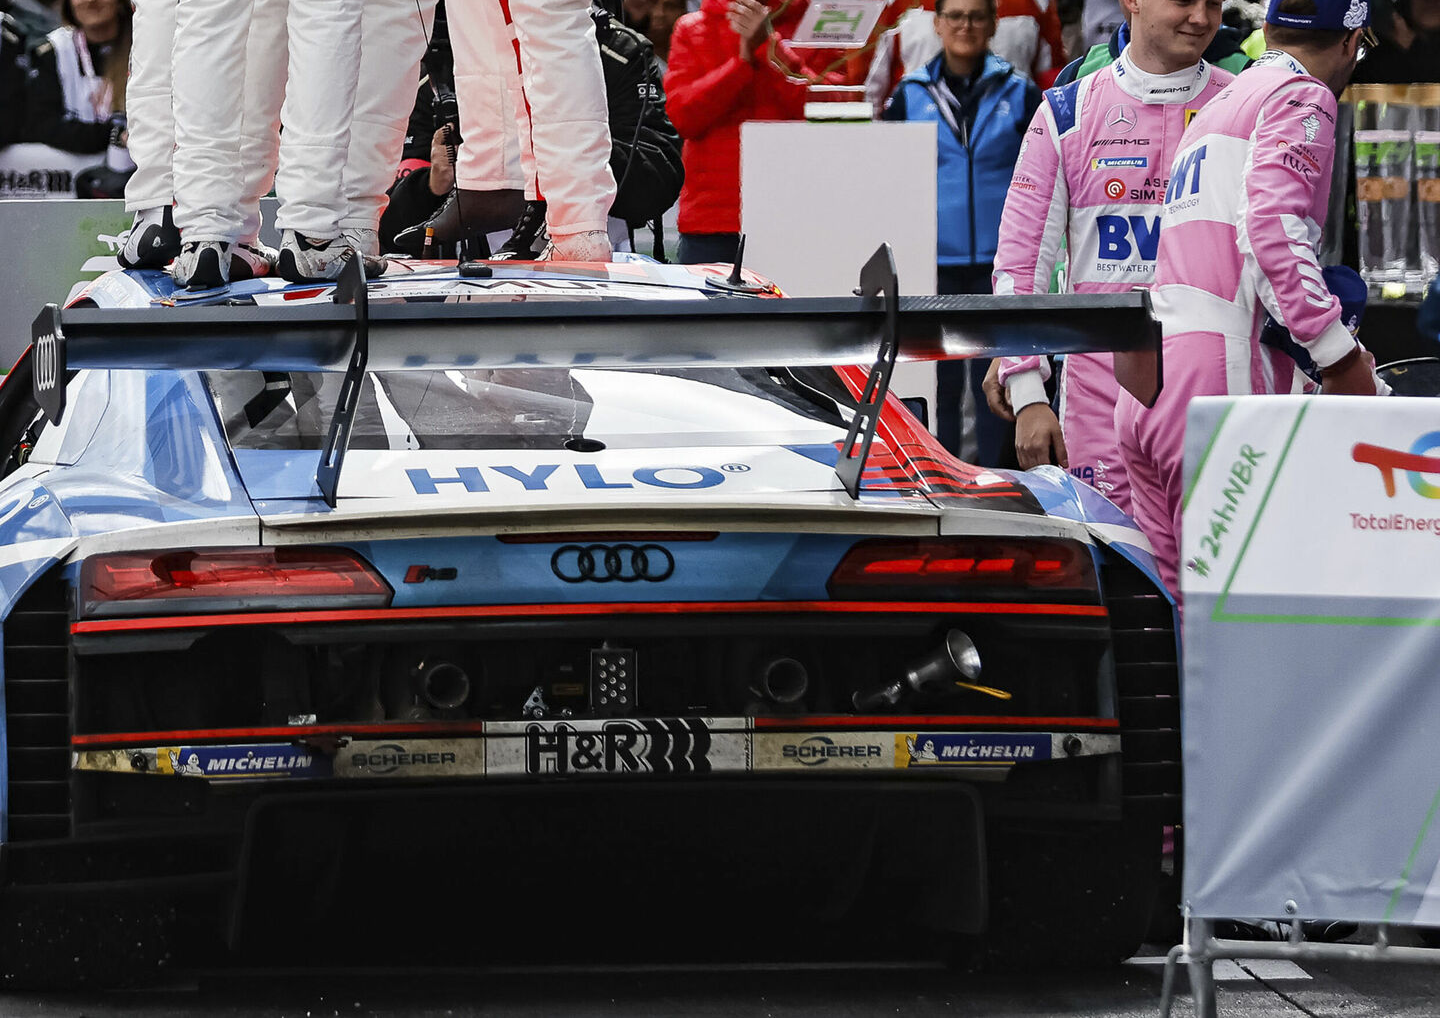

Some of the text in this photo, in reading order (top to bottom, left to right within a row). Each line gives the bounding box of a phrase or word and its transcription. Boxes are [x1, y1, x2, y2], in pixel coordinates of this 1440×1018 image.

[1109, 138, 1151, 146] AMG
[1106, 158, 1144, 166] MICHELIN
[1130, 189, 1156, 200] SIM
[1119, 264, 1148, 272] WATER
[526, 720, 656, 773] H&R
[782, 744, 1035, 758] SCHERER MICHELIN
[207, 751, 457, 771] MICHELIN SCHERER
